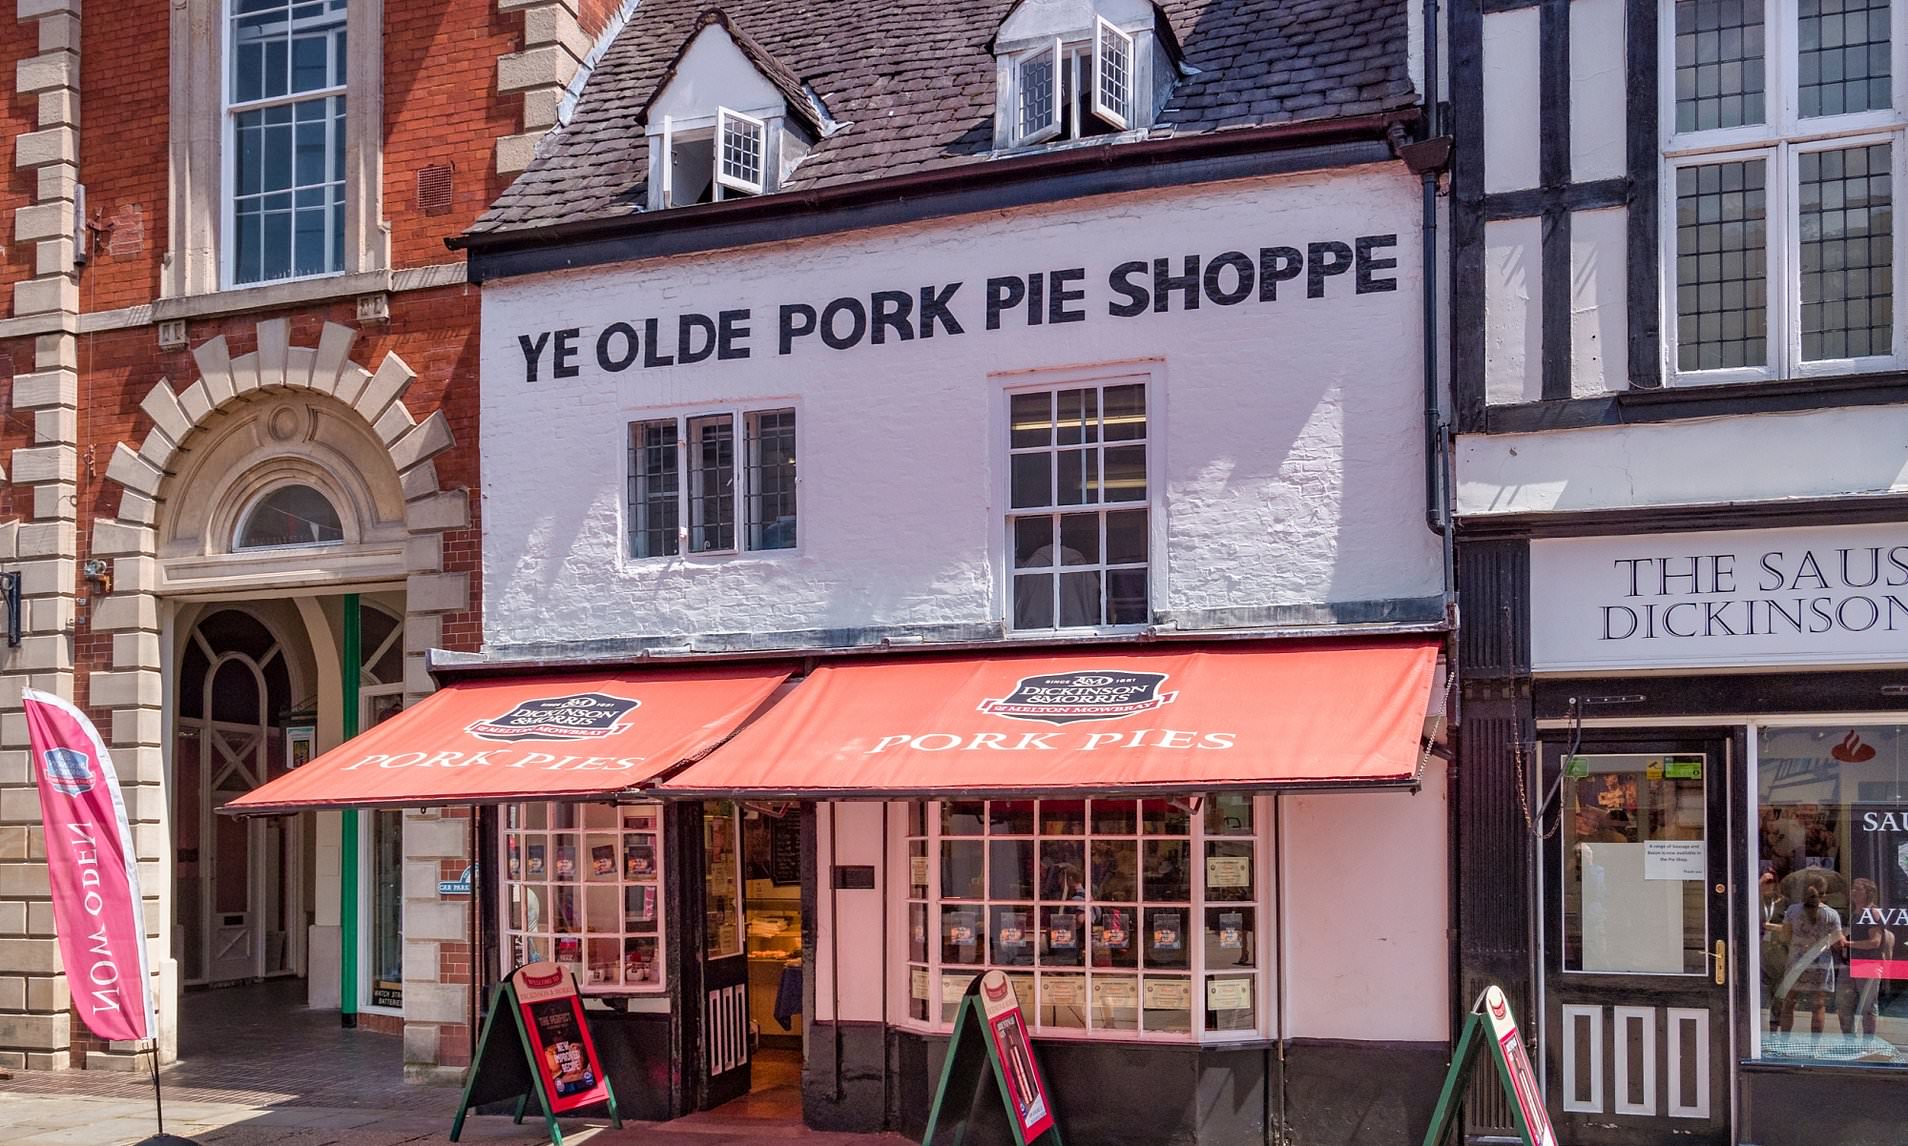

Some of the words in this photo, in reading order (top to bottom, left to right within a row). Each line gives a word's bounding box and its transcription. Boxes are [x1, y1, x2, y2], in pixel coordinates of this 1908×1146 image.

[518, 328, 580, 383] YE
[596, 308, 751, 373] OLDE
[779, 281, 965, 355] PORK
[986, 267, 1086, 331] PIE
[1108, 233, 1397, 317] SHOPPE
[1613, 554, 1737, 597] THE
[1759, 546, 1908, 592] SAUS
[1598, 595, 1908, 640] DICKINSON
[1021, 684, 1149, 696] DICKINSON
[510, 708, 620, 718] DICKINSON
[1005, 705, 1070, 713] MELTON
[1072, 701, 1154, 713] MOWBRAY
[487, 726, 537, 734] MELTON
[535, 726, 609, 736] MOWBRAY
[865, 731, 1063, 754] PORK
[1074, 728, 1238, 751] PIES
[340, 749, 513, 771] PORK
[505, 752, 646, 771] PIES
